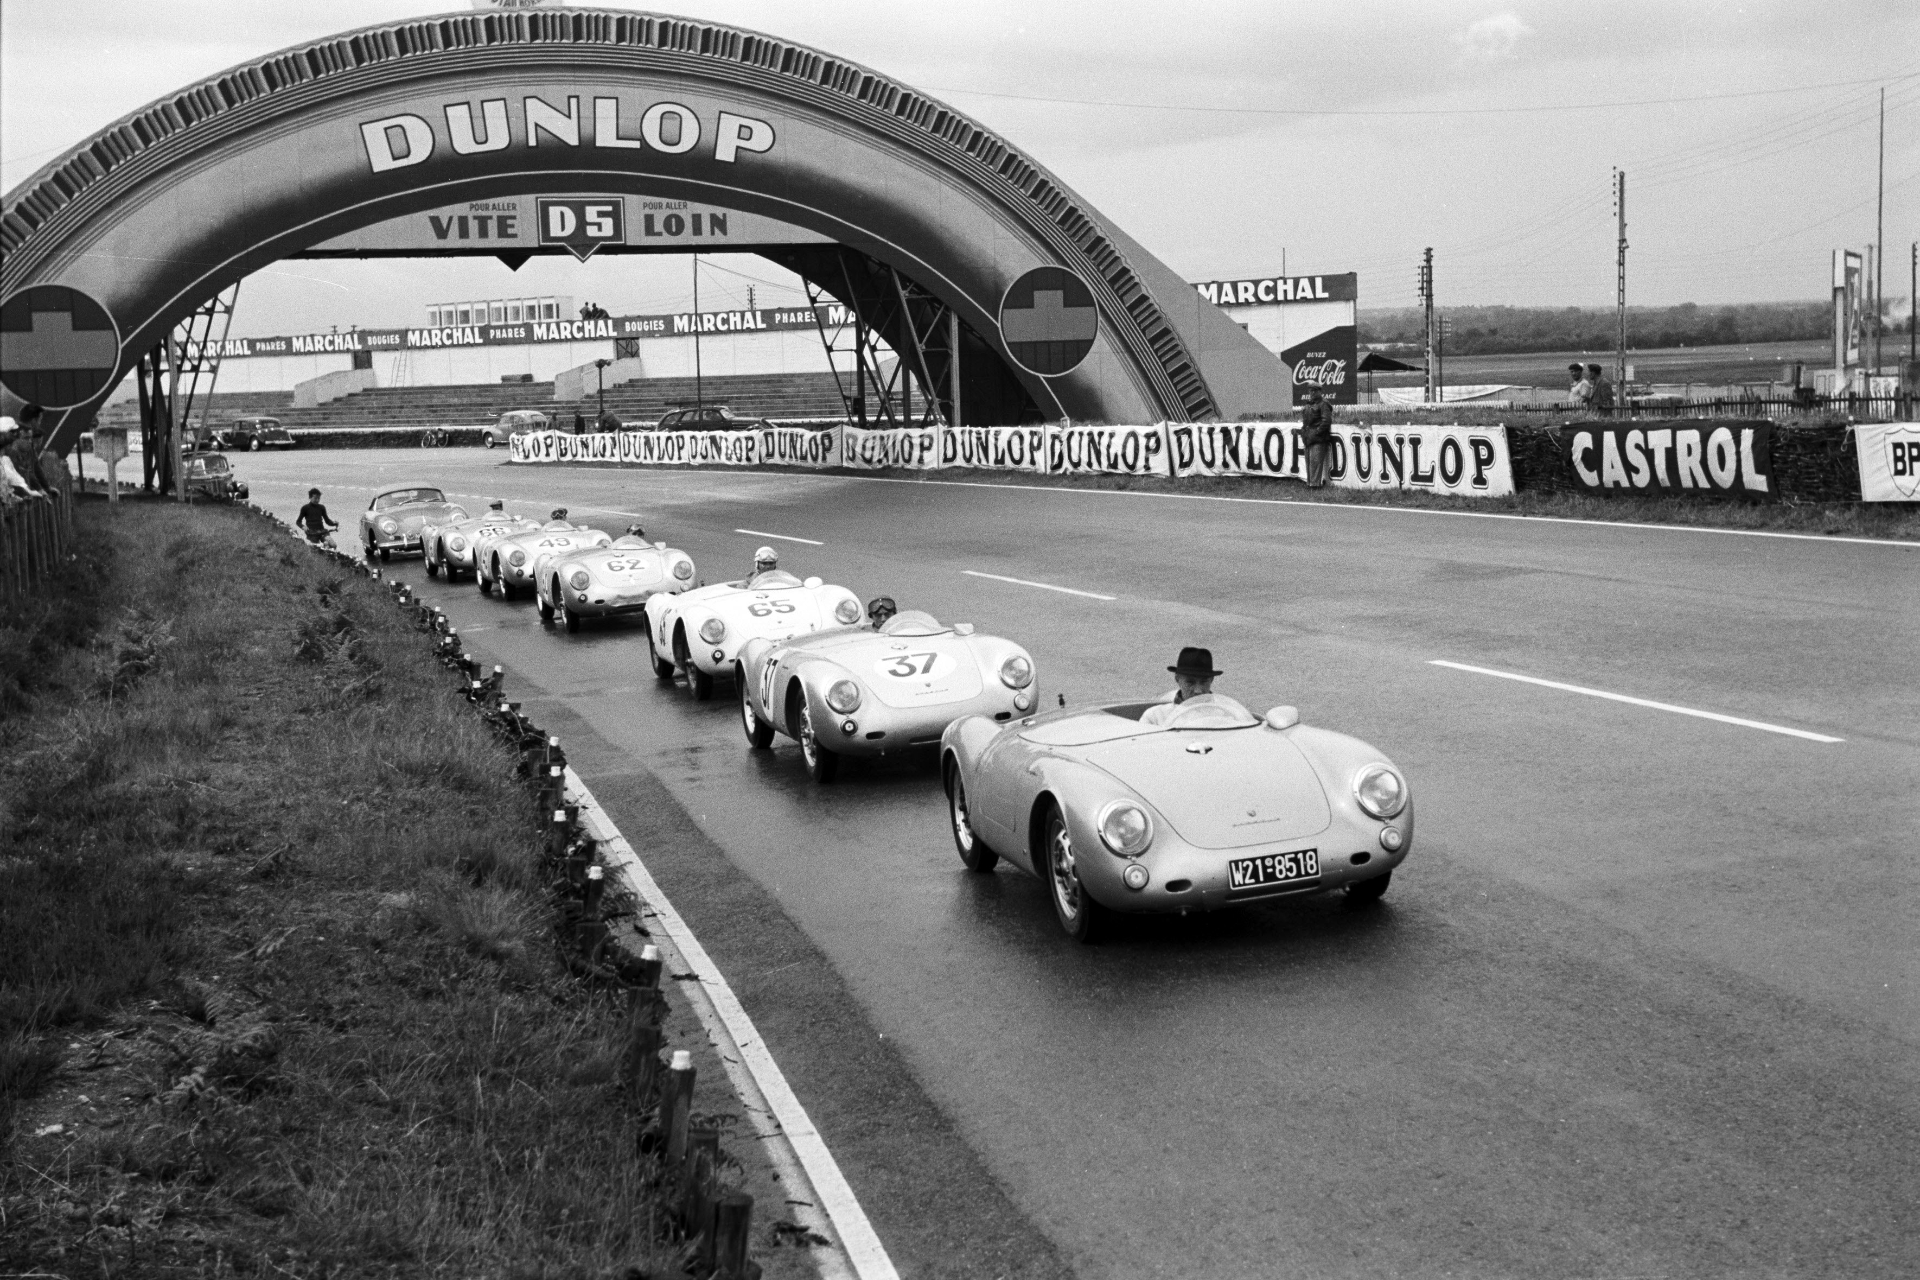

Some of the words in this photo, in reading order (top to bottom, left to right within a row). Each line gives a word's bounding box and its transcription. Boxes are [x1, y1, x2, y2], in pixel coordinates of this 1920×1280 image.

[359, 95, 777, 174] DUNLOP
[469, 202, 491, 212] POUR
[492, 202, 517, 212] ALLER
[643, 201, 664, 210] POUR
[665, 201, 688, 210] ALLER
[428, 214, 518, 240] VITE
[643, 212, 728, 237] LOIN
[1197, 276, 1329, 305] MARCHAL
[255, 340, 286, 351] PHARES
[291, 333, 362, 353] MARCHAL
[367, 333, 400, 346] BOUGIES
[407, 326, 483, 347] MARCHAL
[489, 327, 526, 339] PHARES
[533, 319, 618, 341] MARCHAL
[624, 319, 665, 332] BOUGIES
[673, 310, 767, 333] MARCHAL
[623, 433, 685, 461] DUNLOP
[689, 434, 756, 462] DUNLOP
[763, 430, 833, 462] DUNLOP
[943, 429, 1044, 466] DUNLOP
[1050, 430, 1161, 471] DUNLOP
[1571, 426, 1768, 492] CASTROL
[1891, 441, 1920, 477] BP
[1329, 433, 1496, 490] DUNLOP
[538, 537, 571, 548] 49
[606, 558, 646, 572] 62
[747, 598, 796, 618] 65
[882, 652, 938, 678] 37
